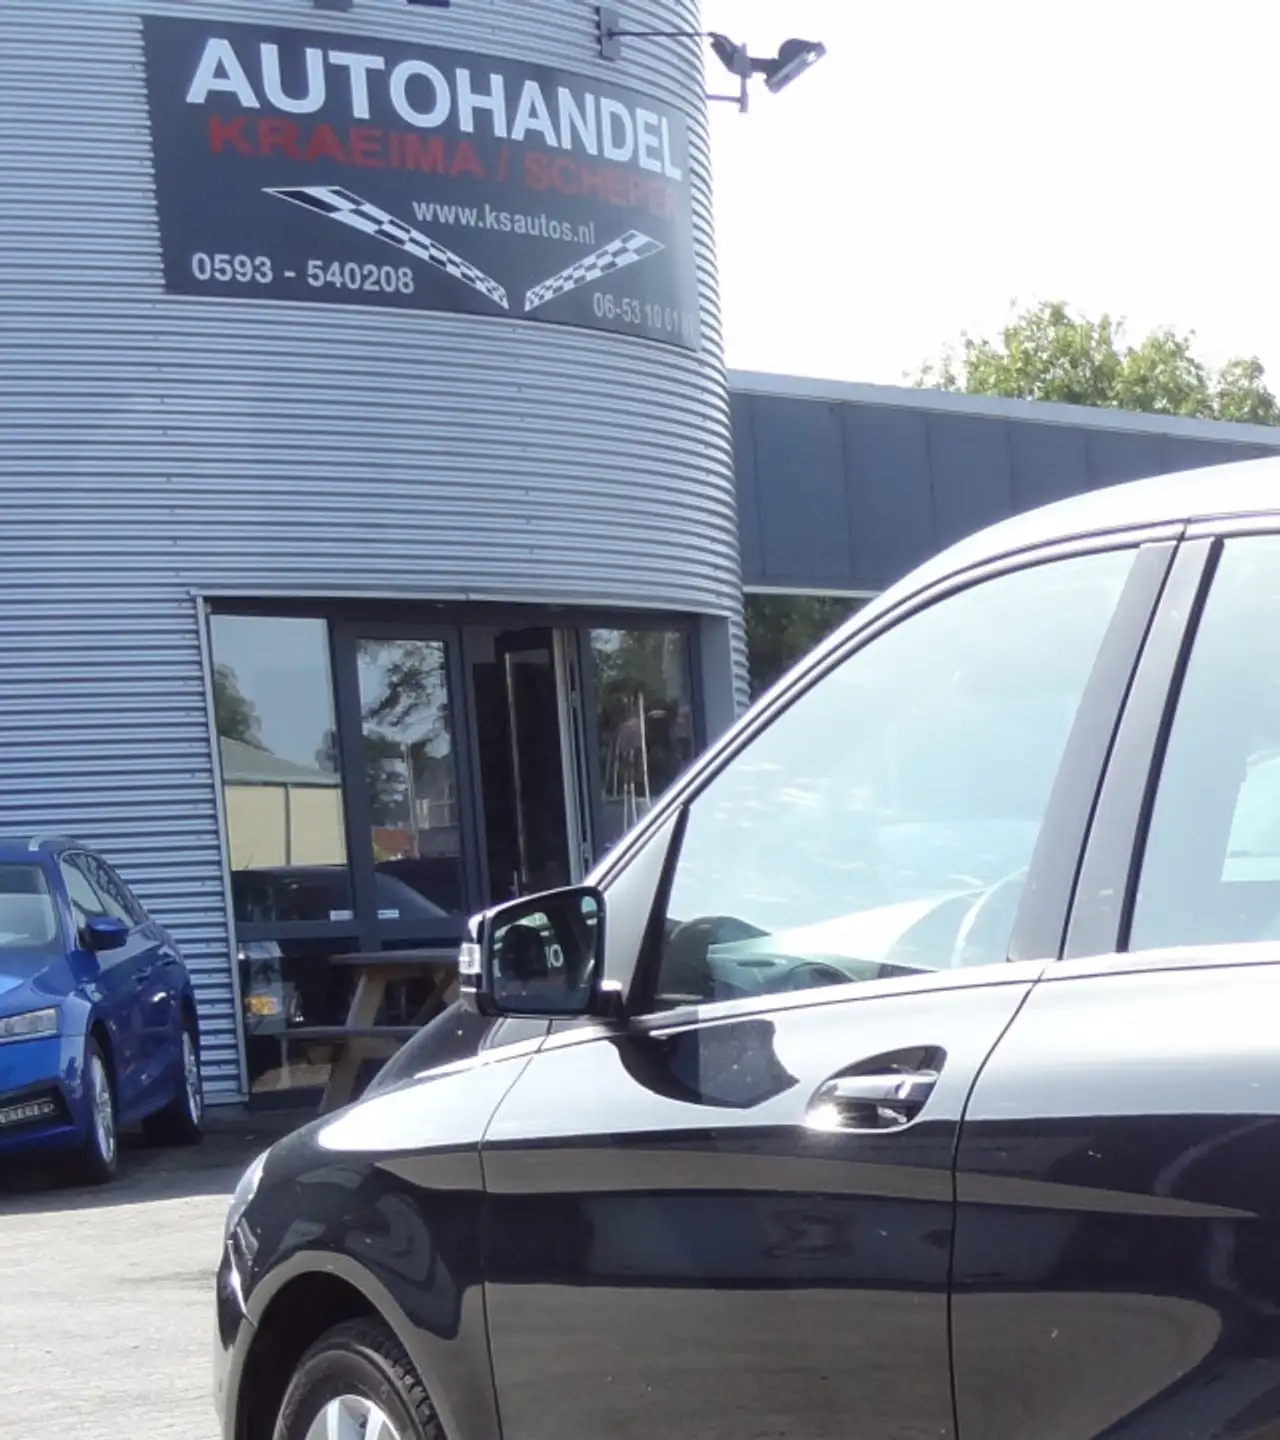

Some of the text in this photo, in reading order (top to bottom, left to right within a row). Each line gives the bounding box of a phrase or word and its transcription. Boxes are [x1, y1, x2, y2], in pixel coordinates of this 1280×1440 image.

[186, 37, 682, 182] AUTOHANDEL
[208, 114, 677, 218] KRAEIMA / SCHEPER
[413, 200, 596, 245] www.ksautos.nl
[191, 251, 273, 285] 0593
[306, 259, 415, 295] 540208
[593, 292, 641, 324] 06-53
